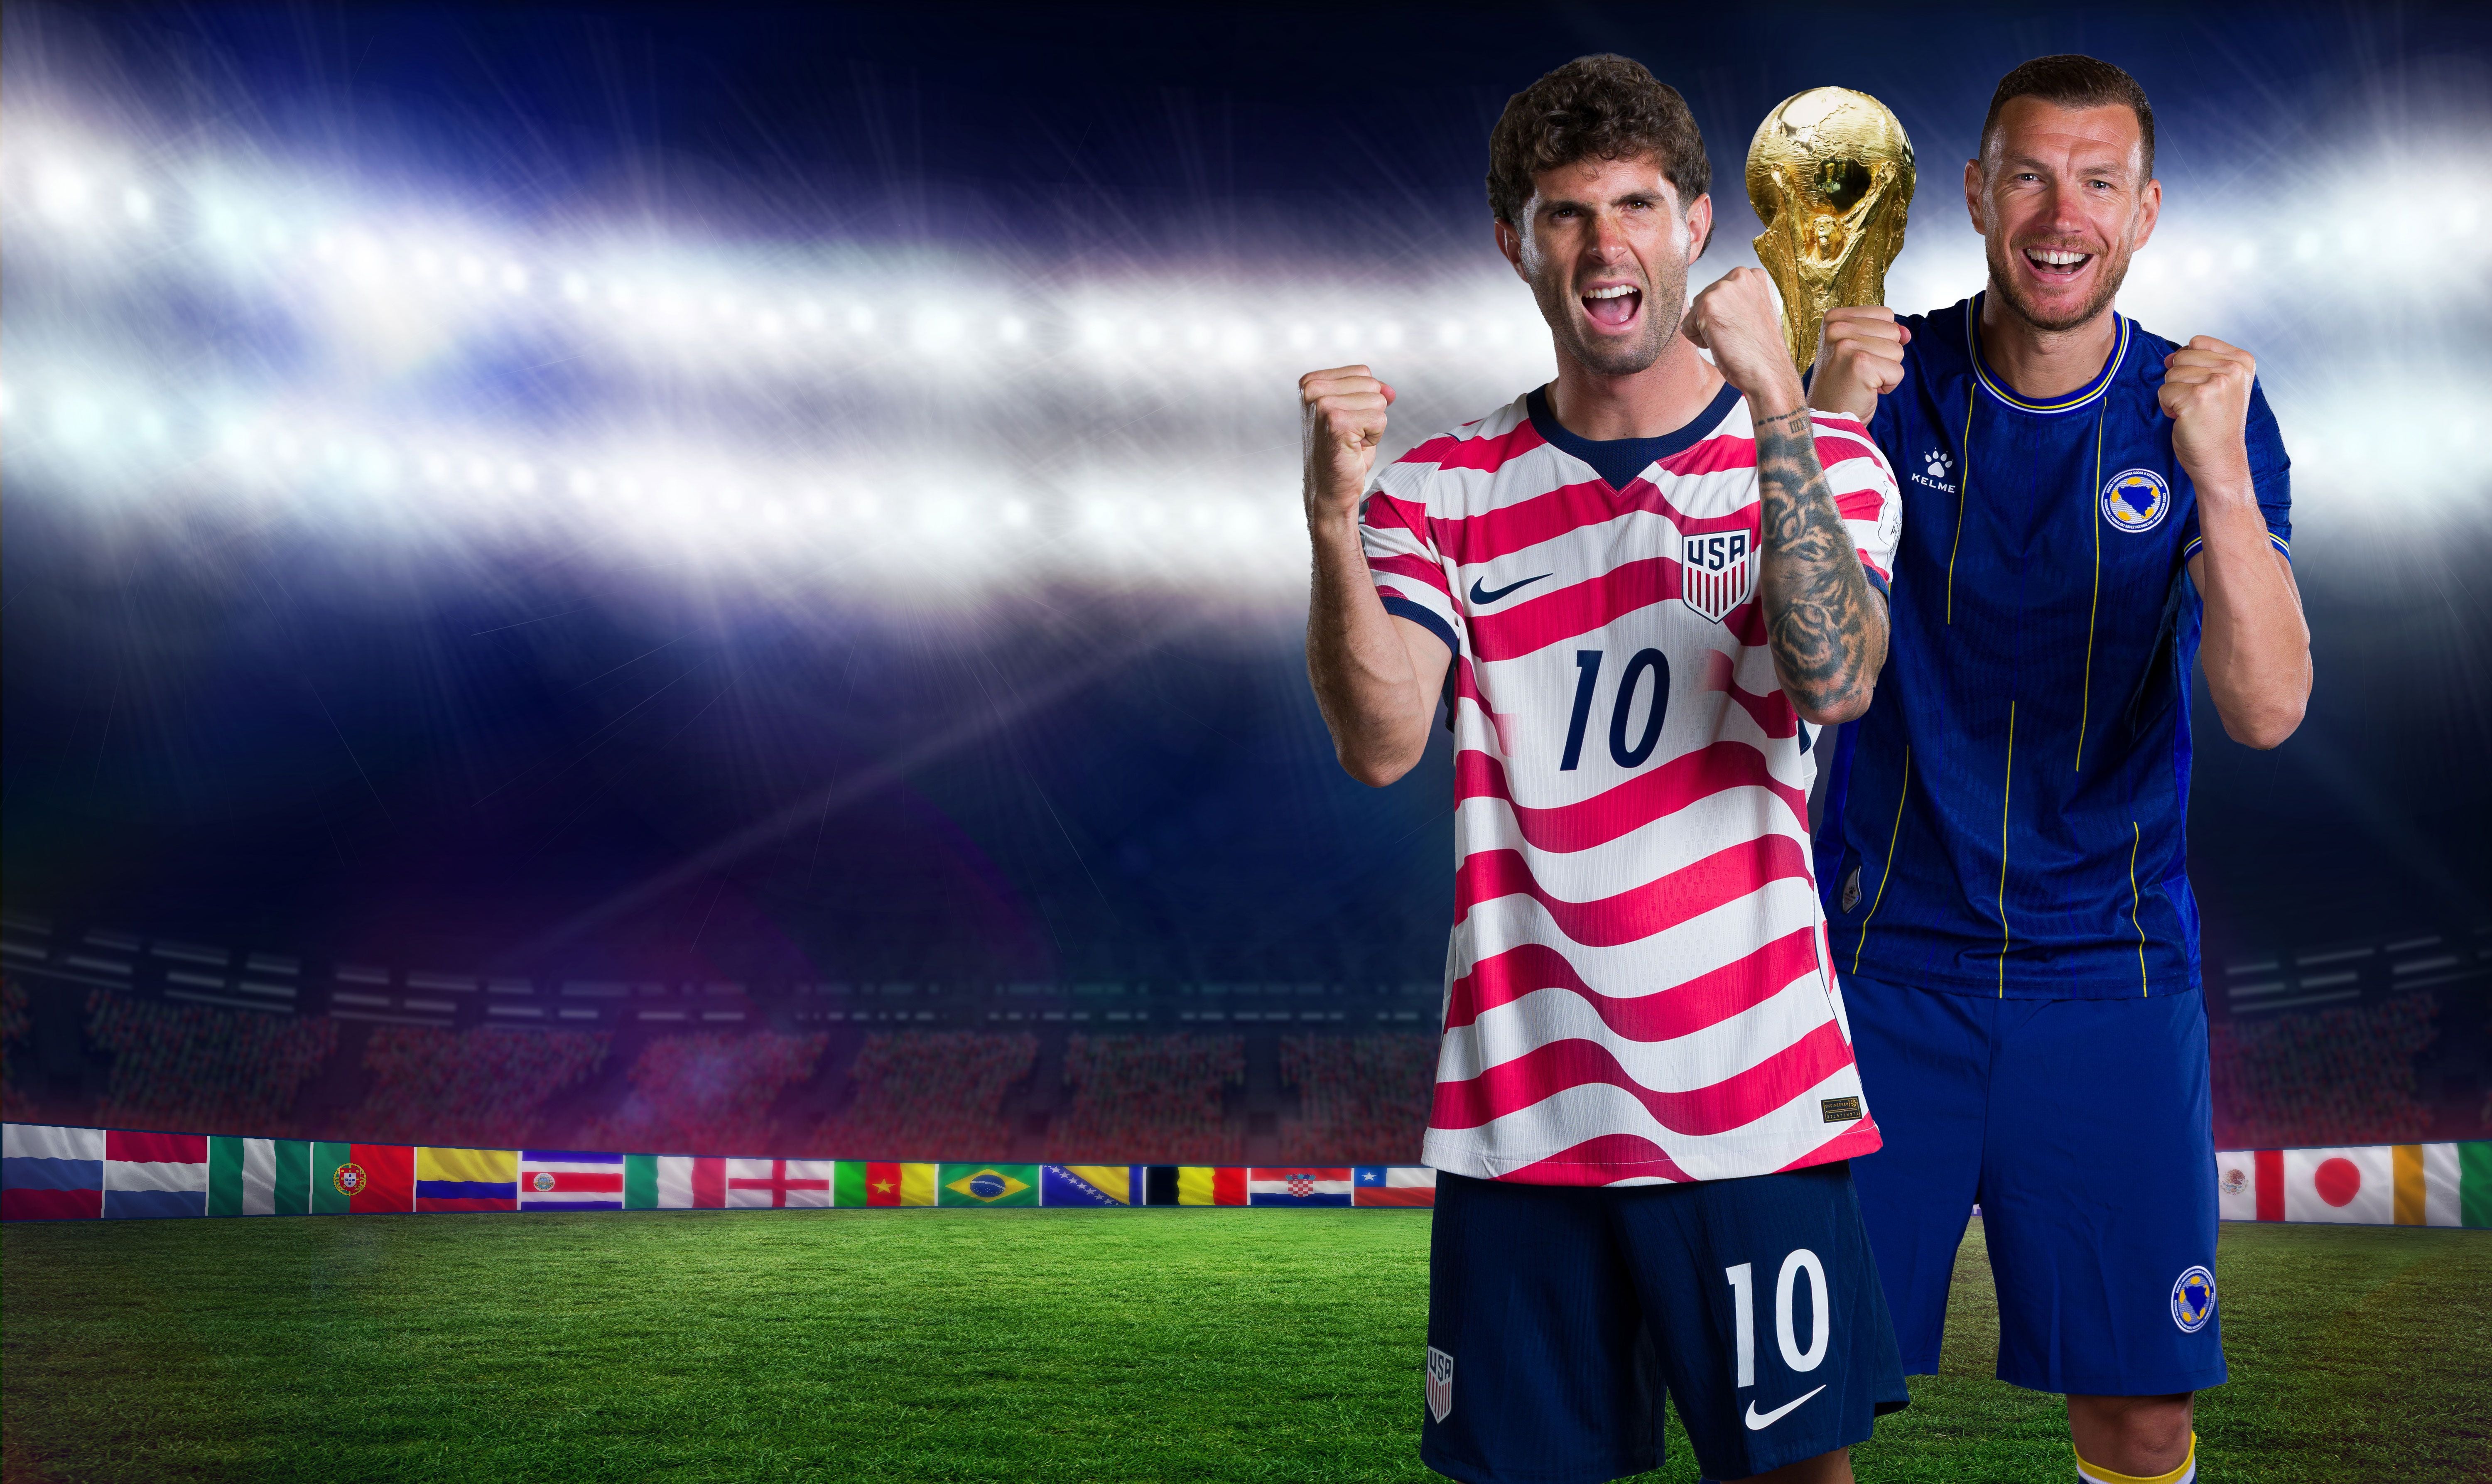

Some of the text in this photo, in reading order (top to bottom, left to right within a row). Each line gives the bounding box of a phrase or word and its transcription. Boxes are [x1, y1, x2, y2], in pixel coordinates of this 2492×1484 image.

[1911, 473, 1956, 493] KELME
[1688, 535, 1745, 571] USA
[1560, 648, 1670, 771] 10
[1726, 1249, 1829, 1388] 10
[1430, 1350, 1452, 1382] USA
